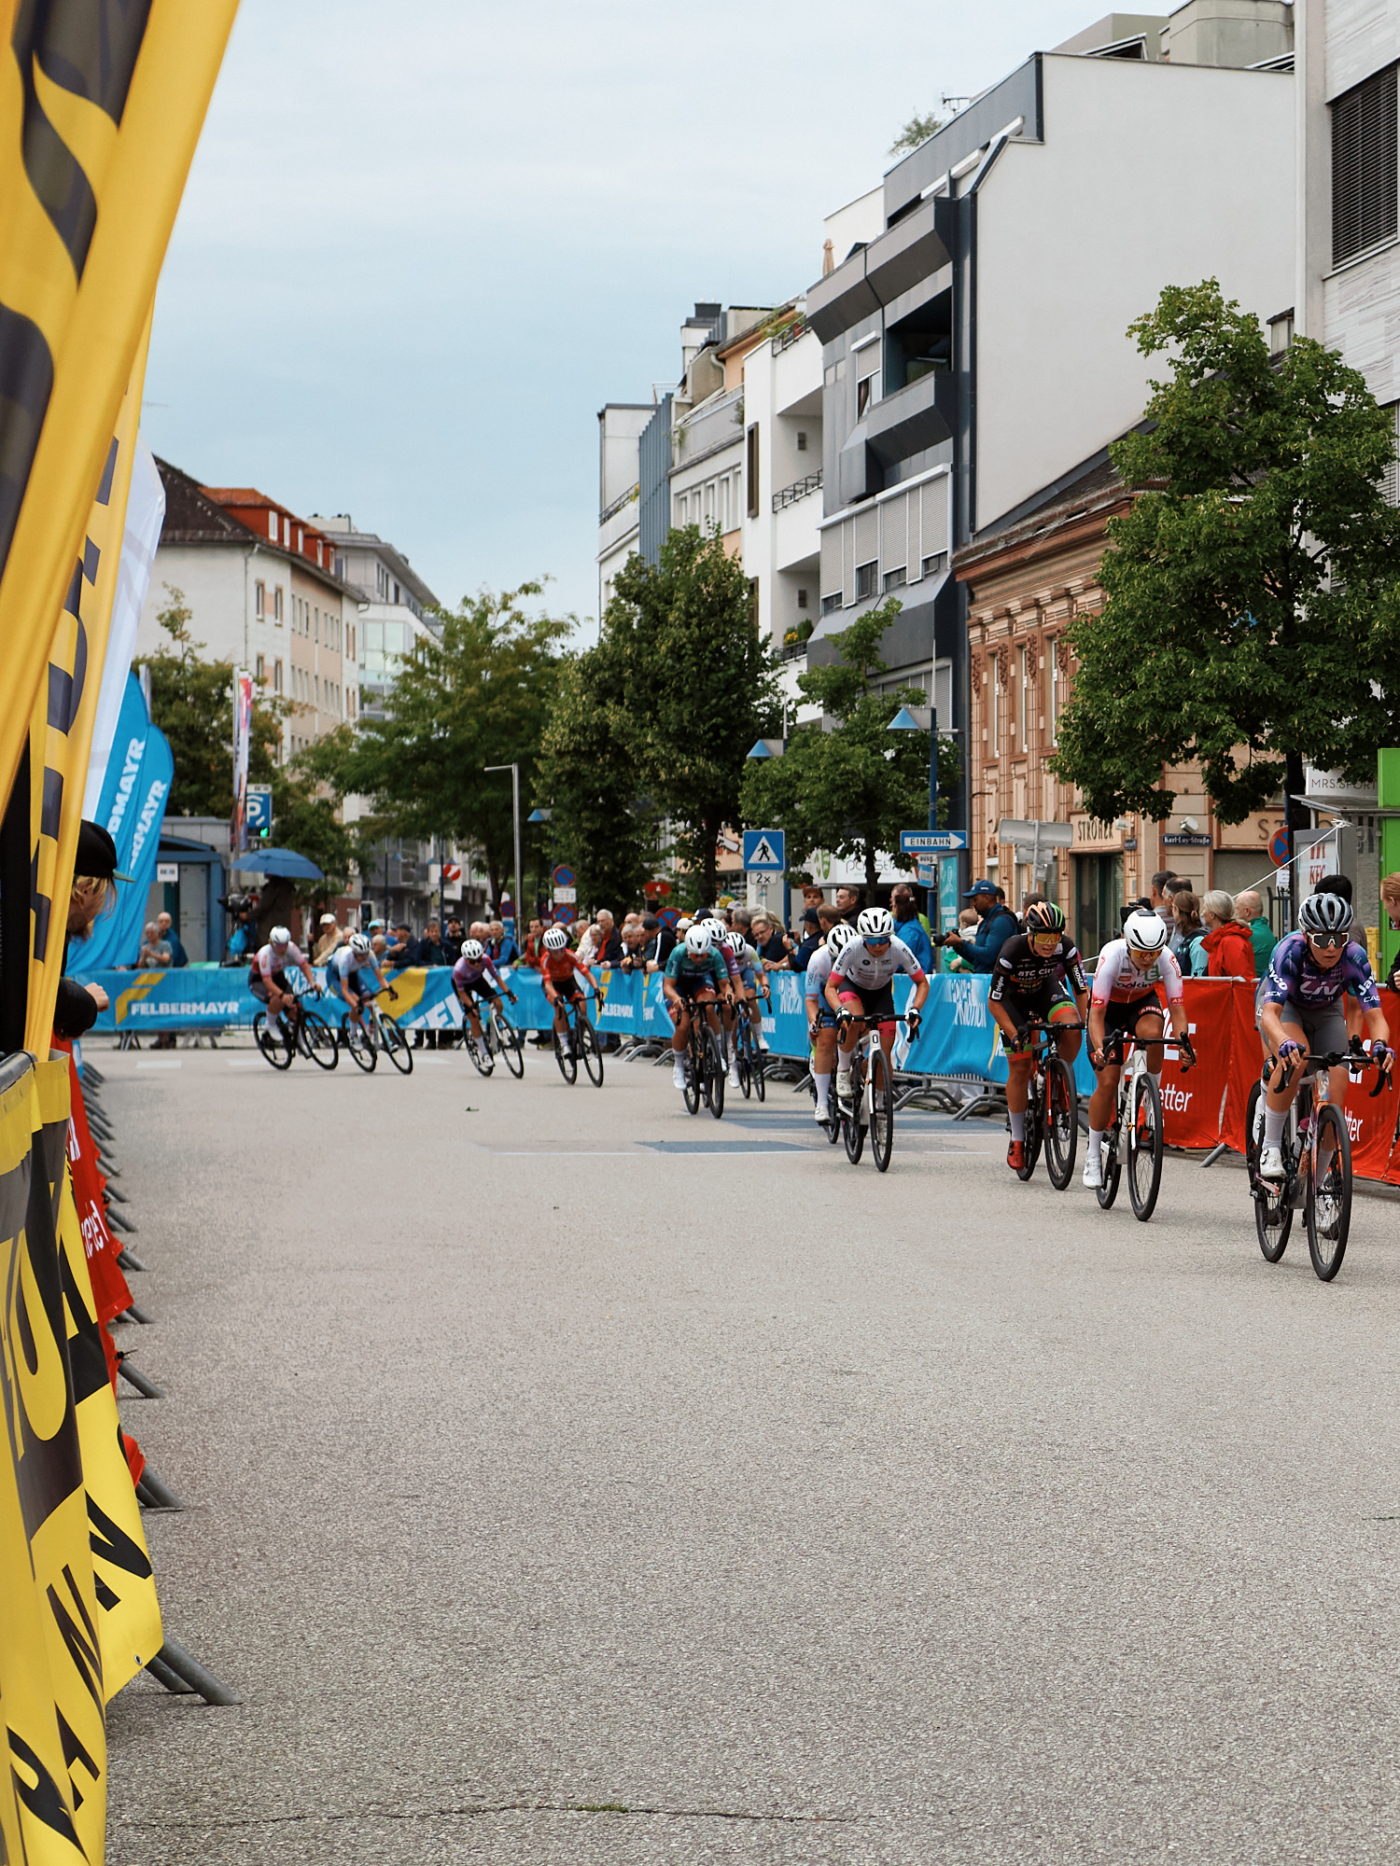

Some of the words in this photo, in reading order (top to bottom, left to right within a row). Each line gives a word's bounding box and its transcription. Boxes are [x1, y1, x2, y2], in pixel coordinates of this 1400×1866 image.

[910, 837, 951, 847] EINBAHN
[1300, 981, 1340, 995] Liv
[131, 1001, 240, 1015] FELBERMAYR
[1159, 1083, 1193, 1113] etter
